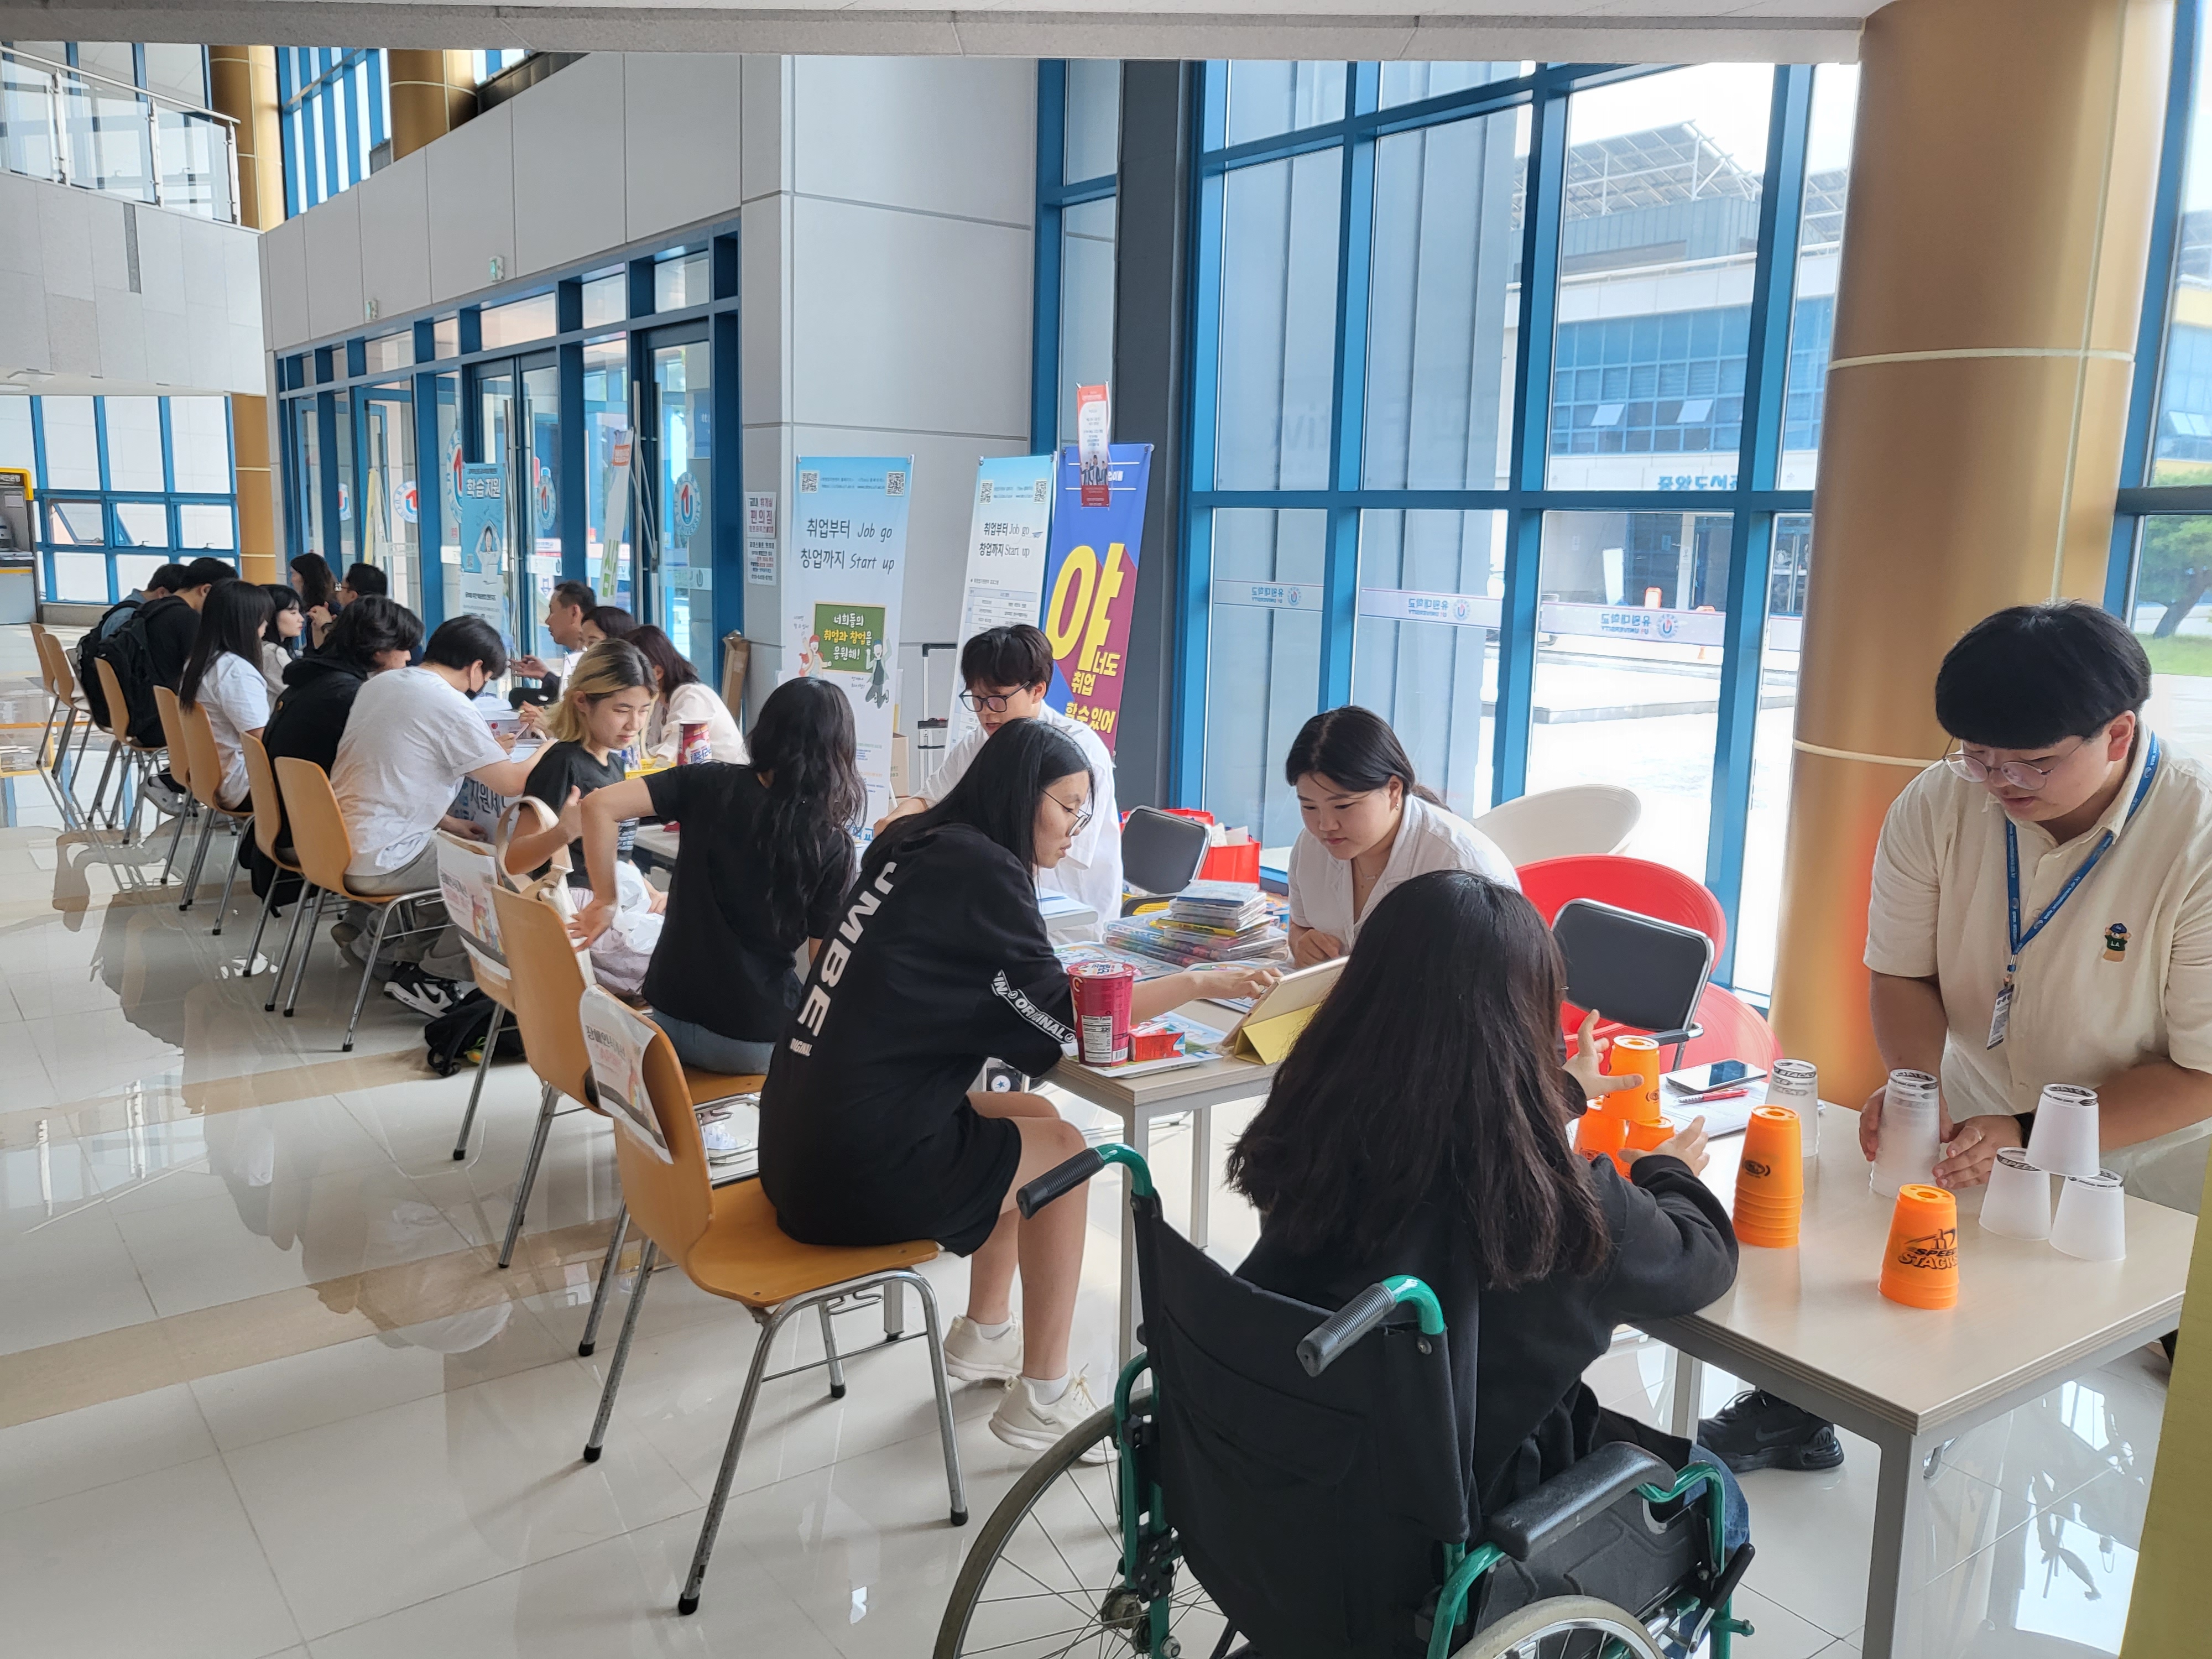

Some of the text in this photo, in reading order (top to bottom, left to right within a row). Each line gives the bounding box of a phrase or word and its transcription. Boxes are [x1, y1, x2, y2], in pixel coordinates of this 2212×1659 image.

[466, 478, 500, 498] 학습지원
[750, 510, 773, 524] 편의점
[807, 518, 892, 542] 취업부터 Job go
[984, 522, 1030, 536] 취업부터 Job go
[979, 542, 1030, 558] 창업까지 Start up
[801, 548, 895, 575] 창업까지 Start up
[1045, 543, 1125, 671] 야
[834, 613, 864, 628] 너희들의
[823, 629, 872, 646] 취업과 창업을
[833, 646, 860, 661] 응원해!
[1093, 651, 1120, 676] 너도
[1071, 671, 1096, 697] 취업
